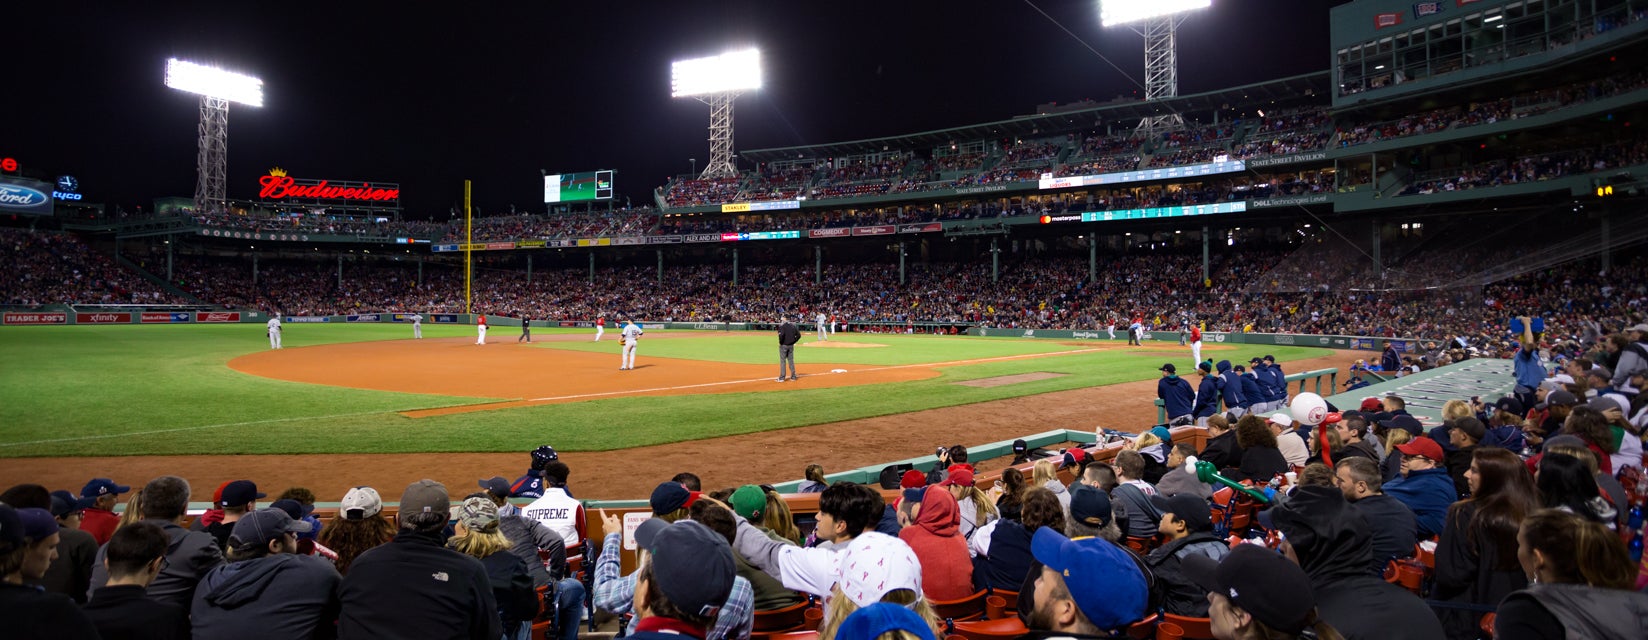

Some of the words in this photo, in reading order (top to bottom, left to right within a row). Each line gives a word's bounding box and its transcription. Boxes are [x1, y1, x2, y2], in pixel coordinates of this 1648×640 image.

[1294, 153, 1326, 161] PAVILION
[259, 175, 399, 200] Budweiser
[53, 190, 82, 200] tyco
[1310, 195, 1326, 203] Level
[90, 314, 119, 322] xfinity
[527, 508, 569, 520] SUPREME
